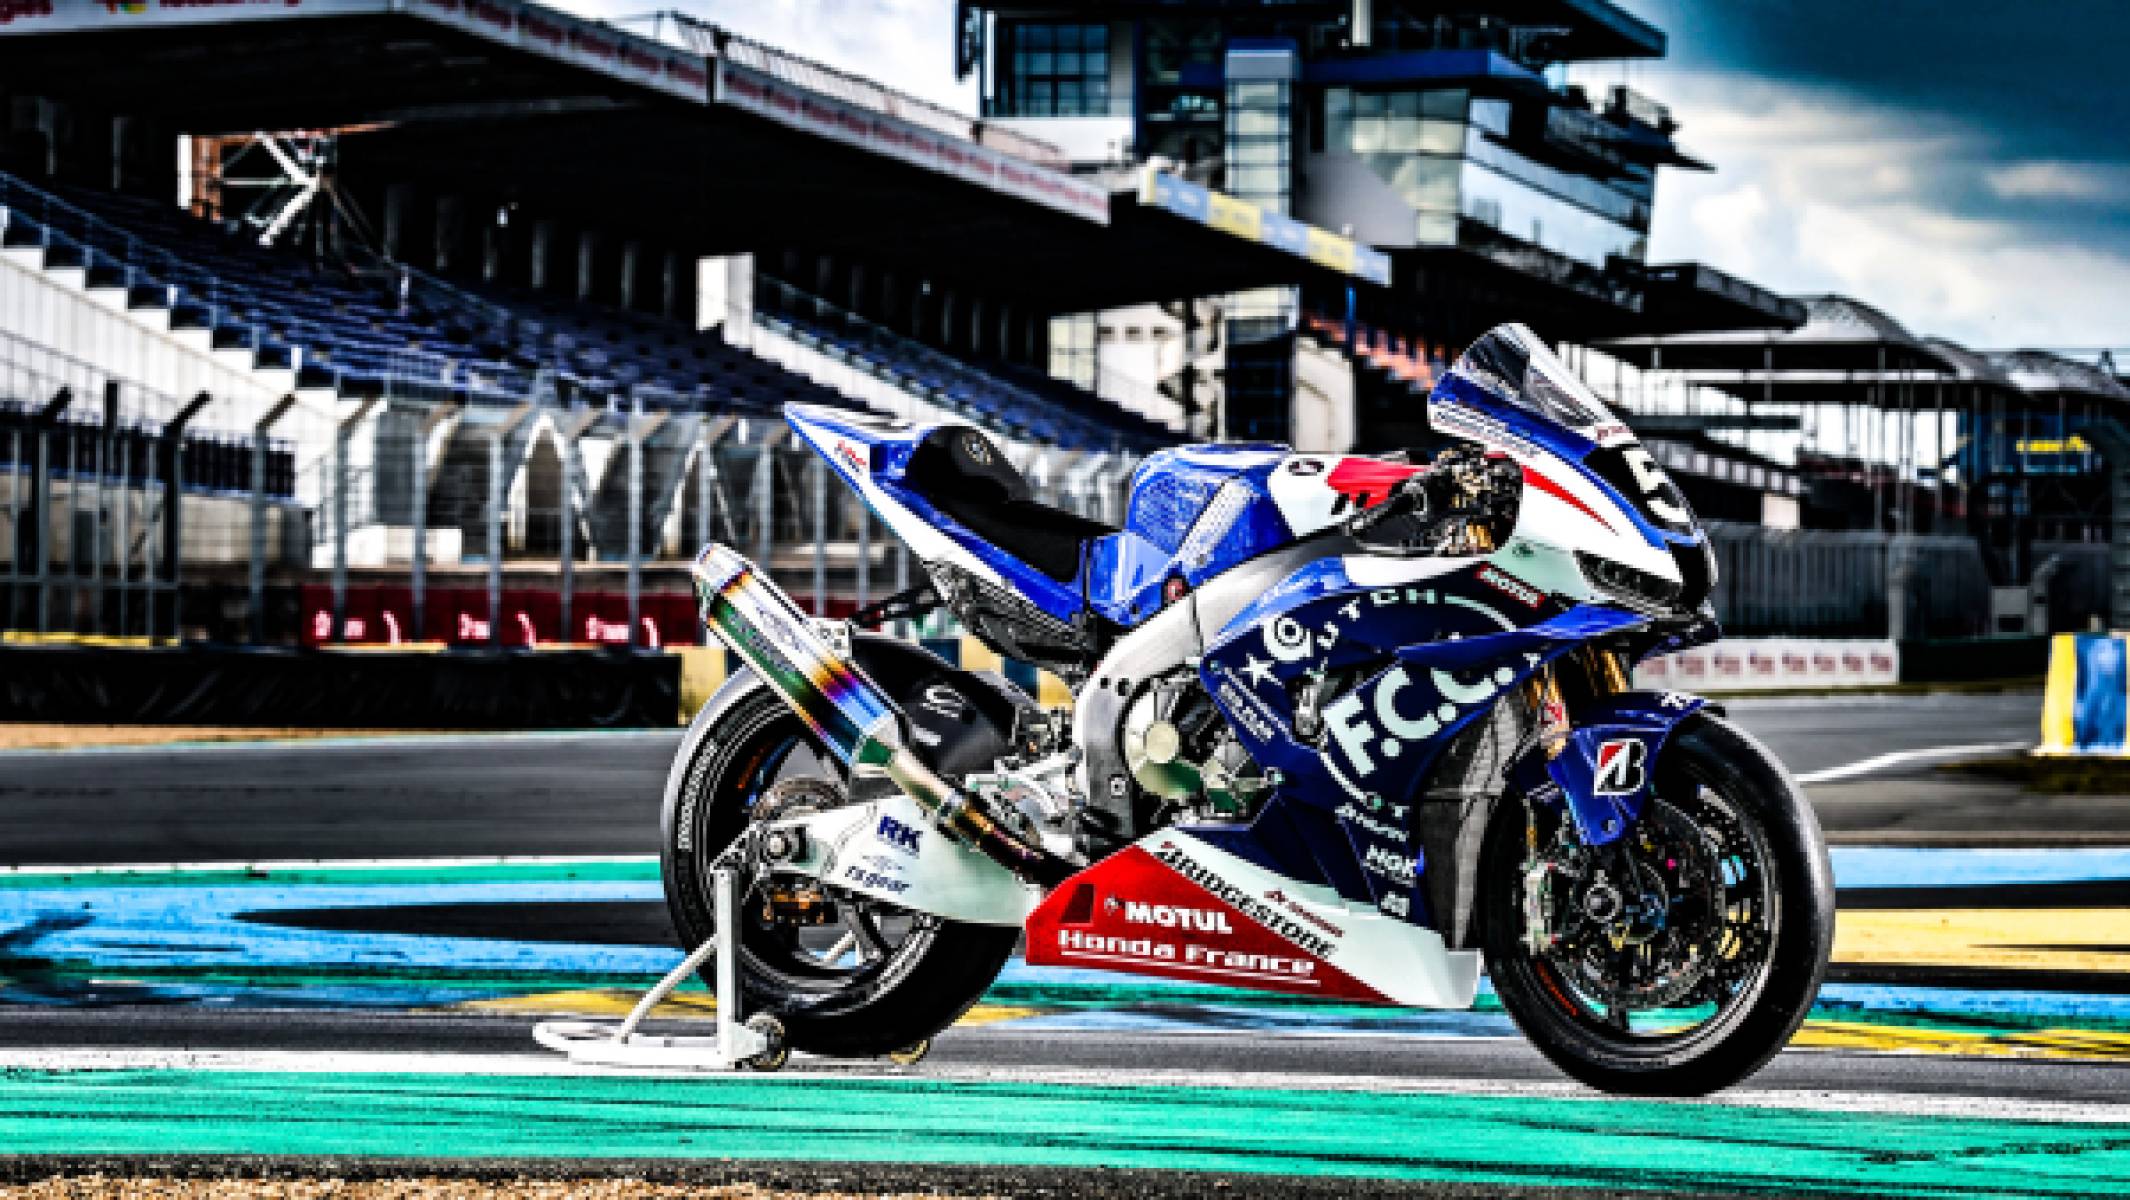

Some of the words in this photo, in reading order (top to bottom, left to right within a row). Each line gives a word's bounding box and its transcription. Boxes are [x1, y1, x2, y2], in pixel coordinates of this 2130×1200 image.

[1622, 448, 1691, 525] 5
[1479, 567, 1539, 608] MOTUL
[877, 814, 923, 852] RK
[1366, 843, 1416, 879] NGK
[1125, 901, 1233, 934] MOTUL
[1154, 841, 1336, 957] BRIDGESTONE
[1058, 929, 1176, 960] Honda
[1185, 943, 1315, 976] France
